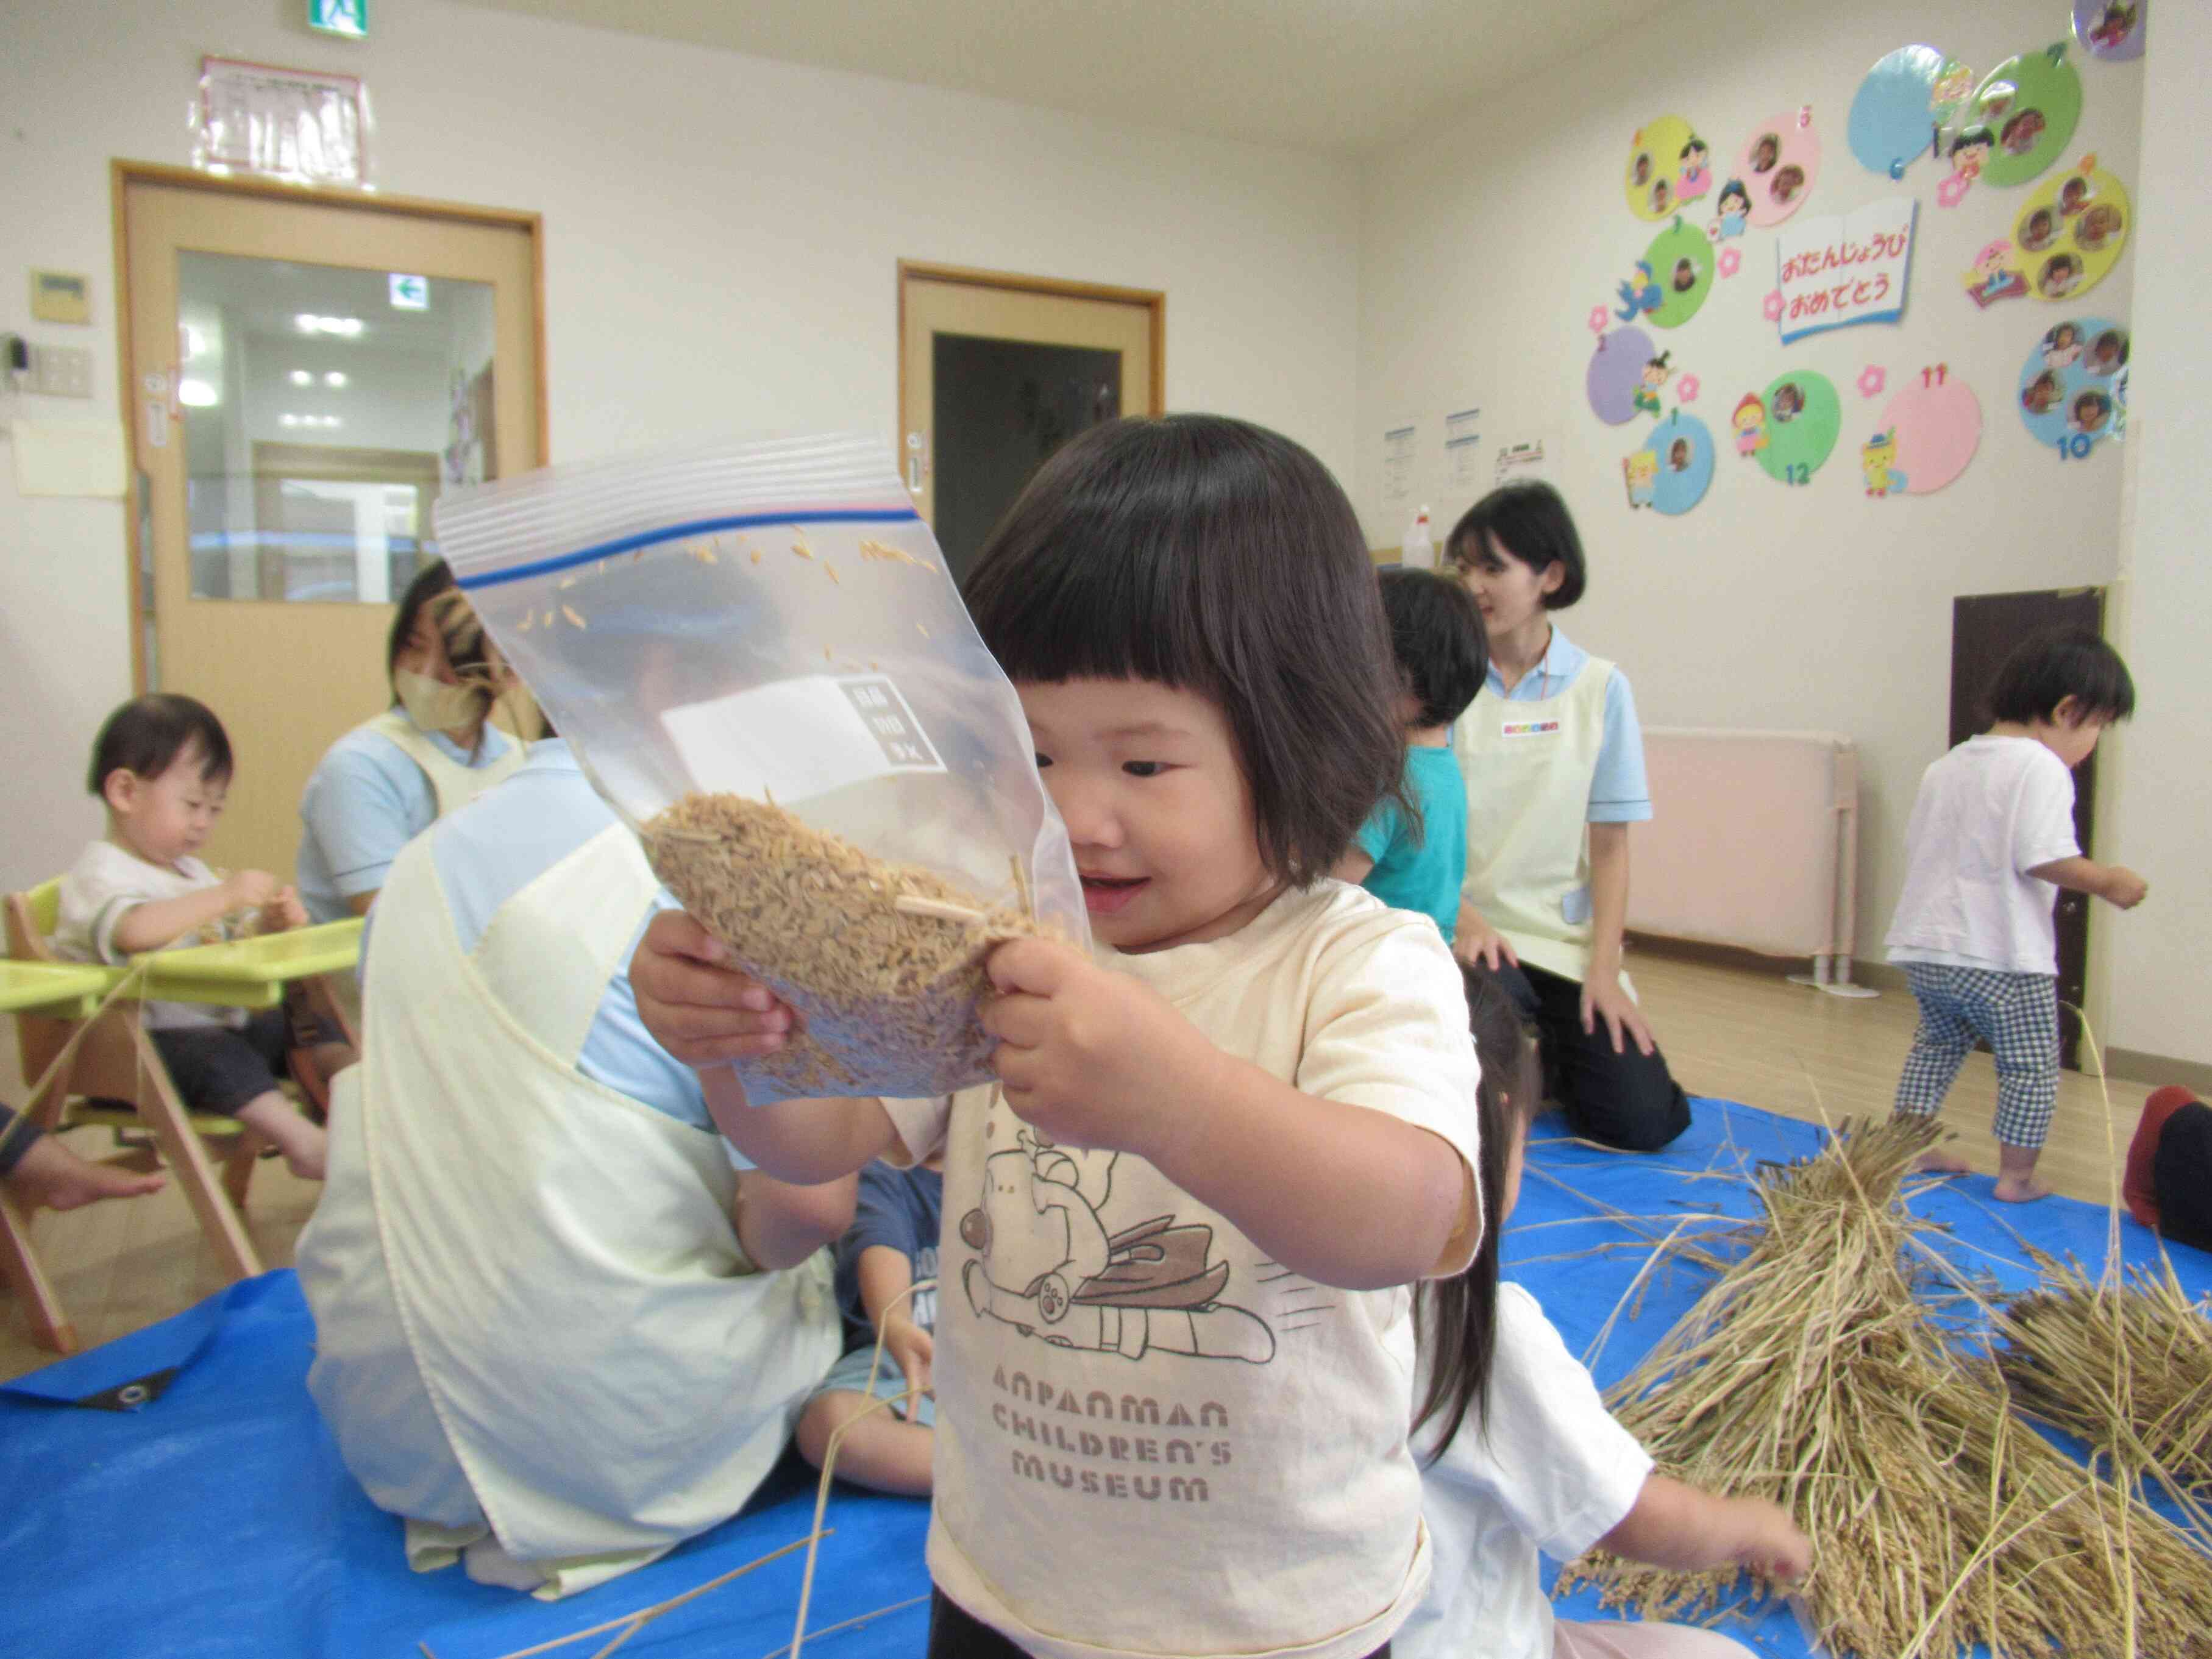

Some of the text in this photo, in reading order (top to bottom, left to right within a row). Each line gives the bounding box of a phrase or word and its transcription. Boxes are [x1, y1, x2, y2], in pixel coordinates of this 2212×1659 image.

[1782, 223, 1909, 283] おたんじょうび
[1789, 273, 1889, 319] おめでとう
[1922, 363, 1947, 389] 11
[2057, 433, 2091, 461] 10
[1786, 463, 1810, 486] 12
[992, 1363, 1229, 1427] ANPANMAN
[992, 1402, 1232, 1466] CHILDREN'S
[1011, 1449, 1209, 1502] MUSEUM
